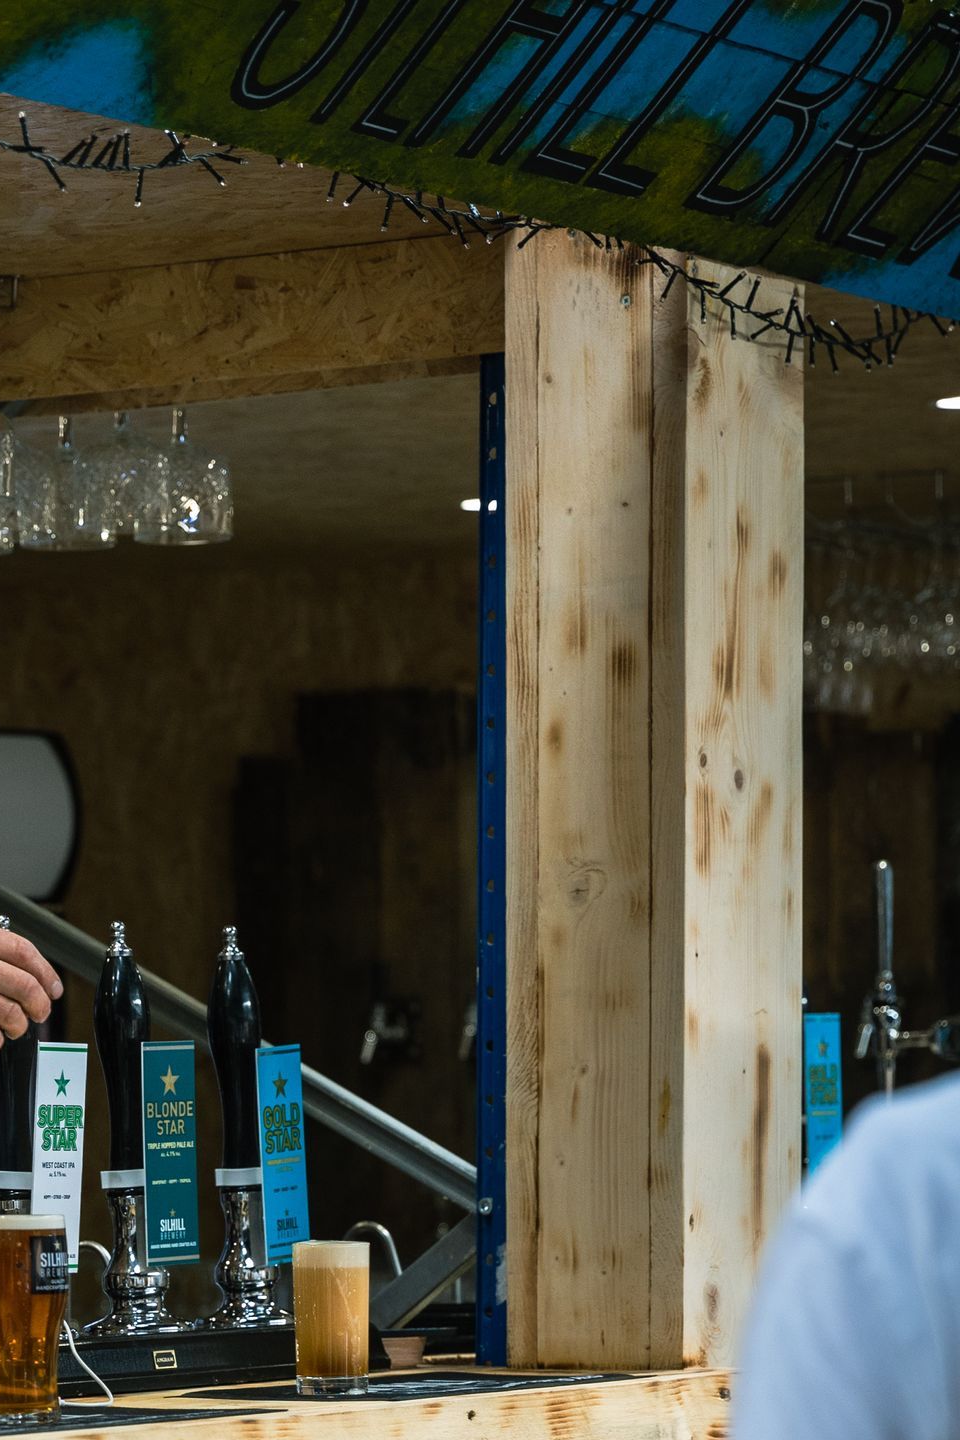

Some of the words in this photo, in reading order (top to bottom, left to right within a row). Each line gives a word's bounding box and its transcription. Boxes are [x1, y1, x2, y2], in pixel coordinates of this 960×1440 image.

[37, 1104, 83, 1128] SUPER
[146, 1101, 193, 1118] BLONDE
[263, 1103, 300, 1129] GOLD
[41, 1127, 77, 1151] STAR
[157, 1119, 185, 1136] STAR
[265, 1127, 302, 1154] STAR
[160, 1217, 186, 1232] SILHILL
